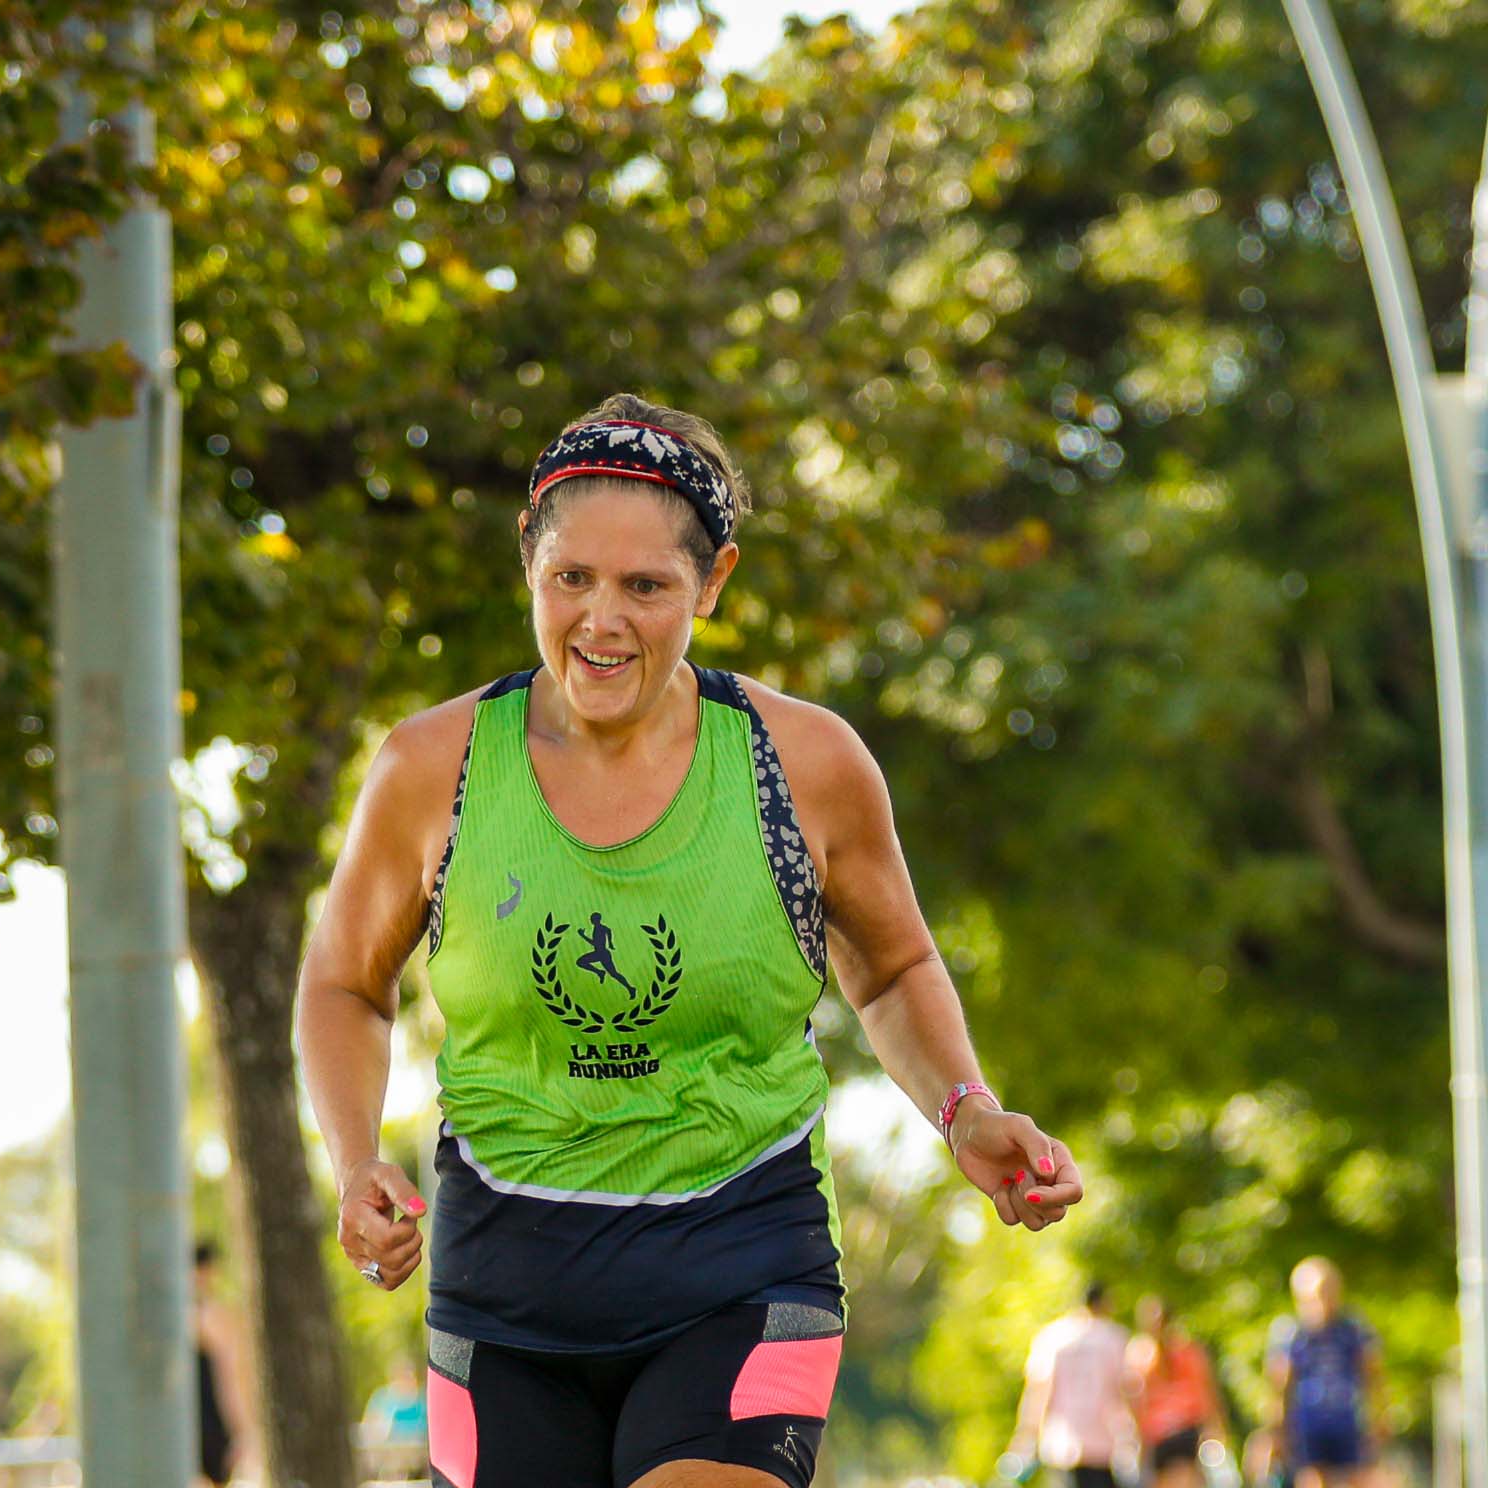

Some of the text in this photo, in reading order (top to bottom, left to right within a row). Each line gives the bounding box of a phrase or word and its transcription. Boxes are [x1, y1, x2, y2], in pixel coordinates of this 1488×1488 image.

[570, 1043, 651, 1060] LA ERA
[568, 1059, 660, 1079] RUNNING
